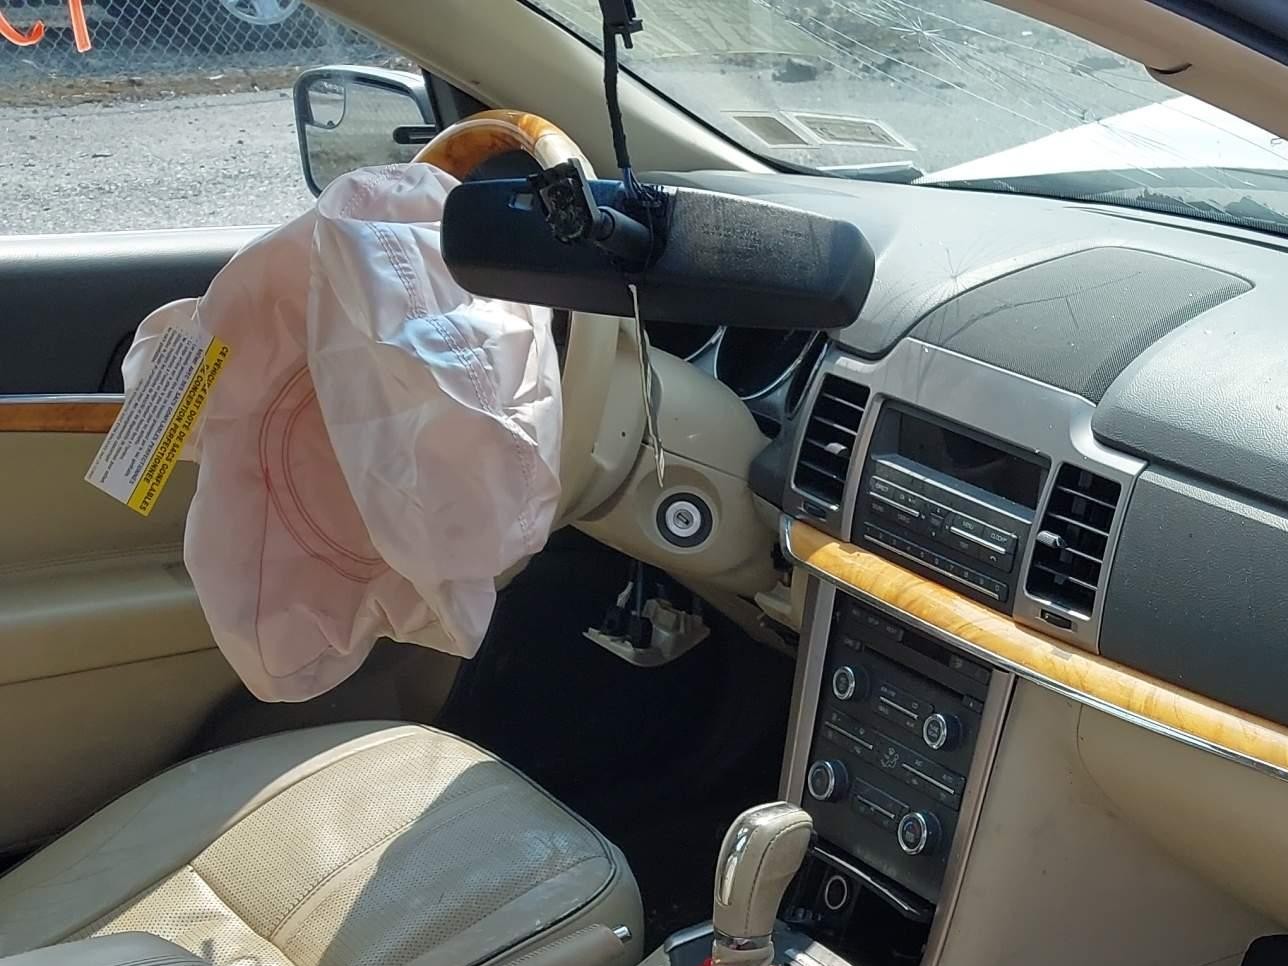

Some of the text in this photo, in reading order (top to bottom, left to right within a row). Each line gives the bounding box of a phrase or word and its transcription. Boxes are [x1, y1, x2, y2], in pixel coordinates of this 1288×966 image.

[217, 345, 229, 359] CE
[174, 374, 204, 422] CONCEPTION
[191, 393, 204, 409] EST
[174, 430, 185, 442] DE
[163, 442, 179, 463] SACS
[138, 462, 168, 511] GONFLABLES
